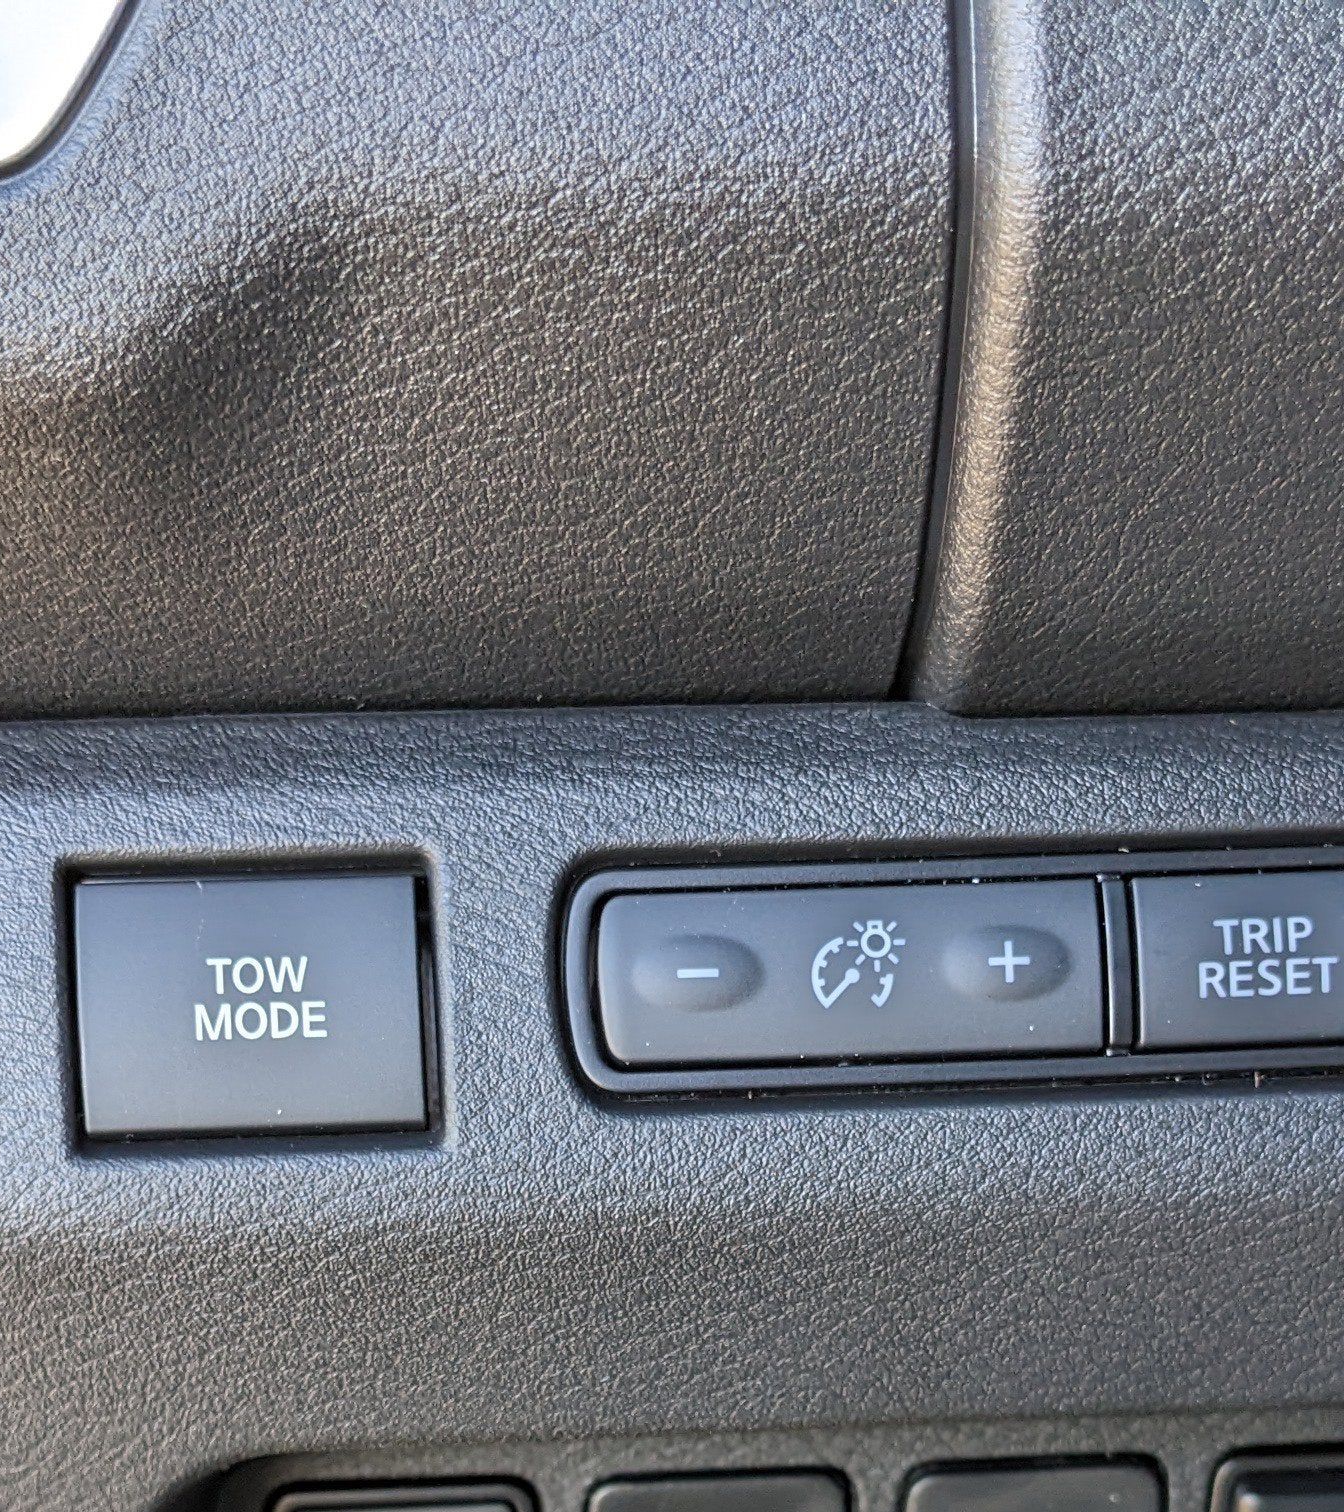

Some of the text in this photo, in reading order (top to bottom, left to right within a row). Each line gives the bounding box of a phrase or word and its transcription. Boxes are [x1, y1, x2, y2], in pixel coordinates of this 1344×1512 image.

[1212, 916, 1315, 954] TRIP
[206, 956, 308, 995] TOW
[1198, 956, 1339, 999] RESET
[194, 1001, 328, 1041] MODE
